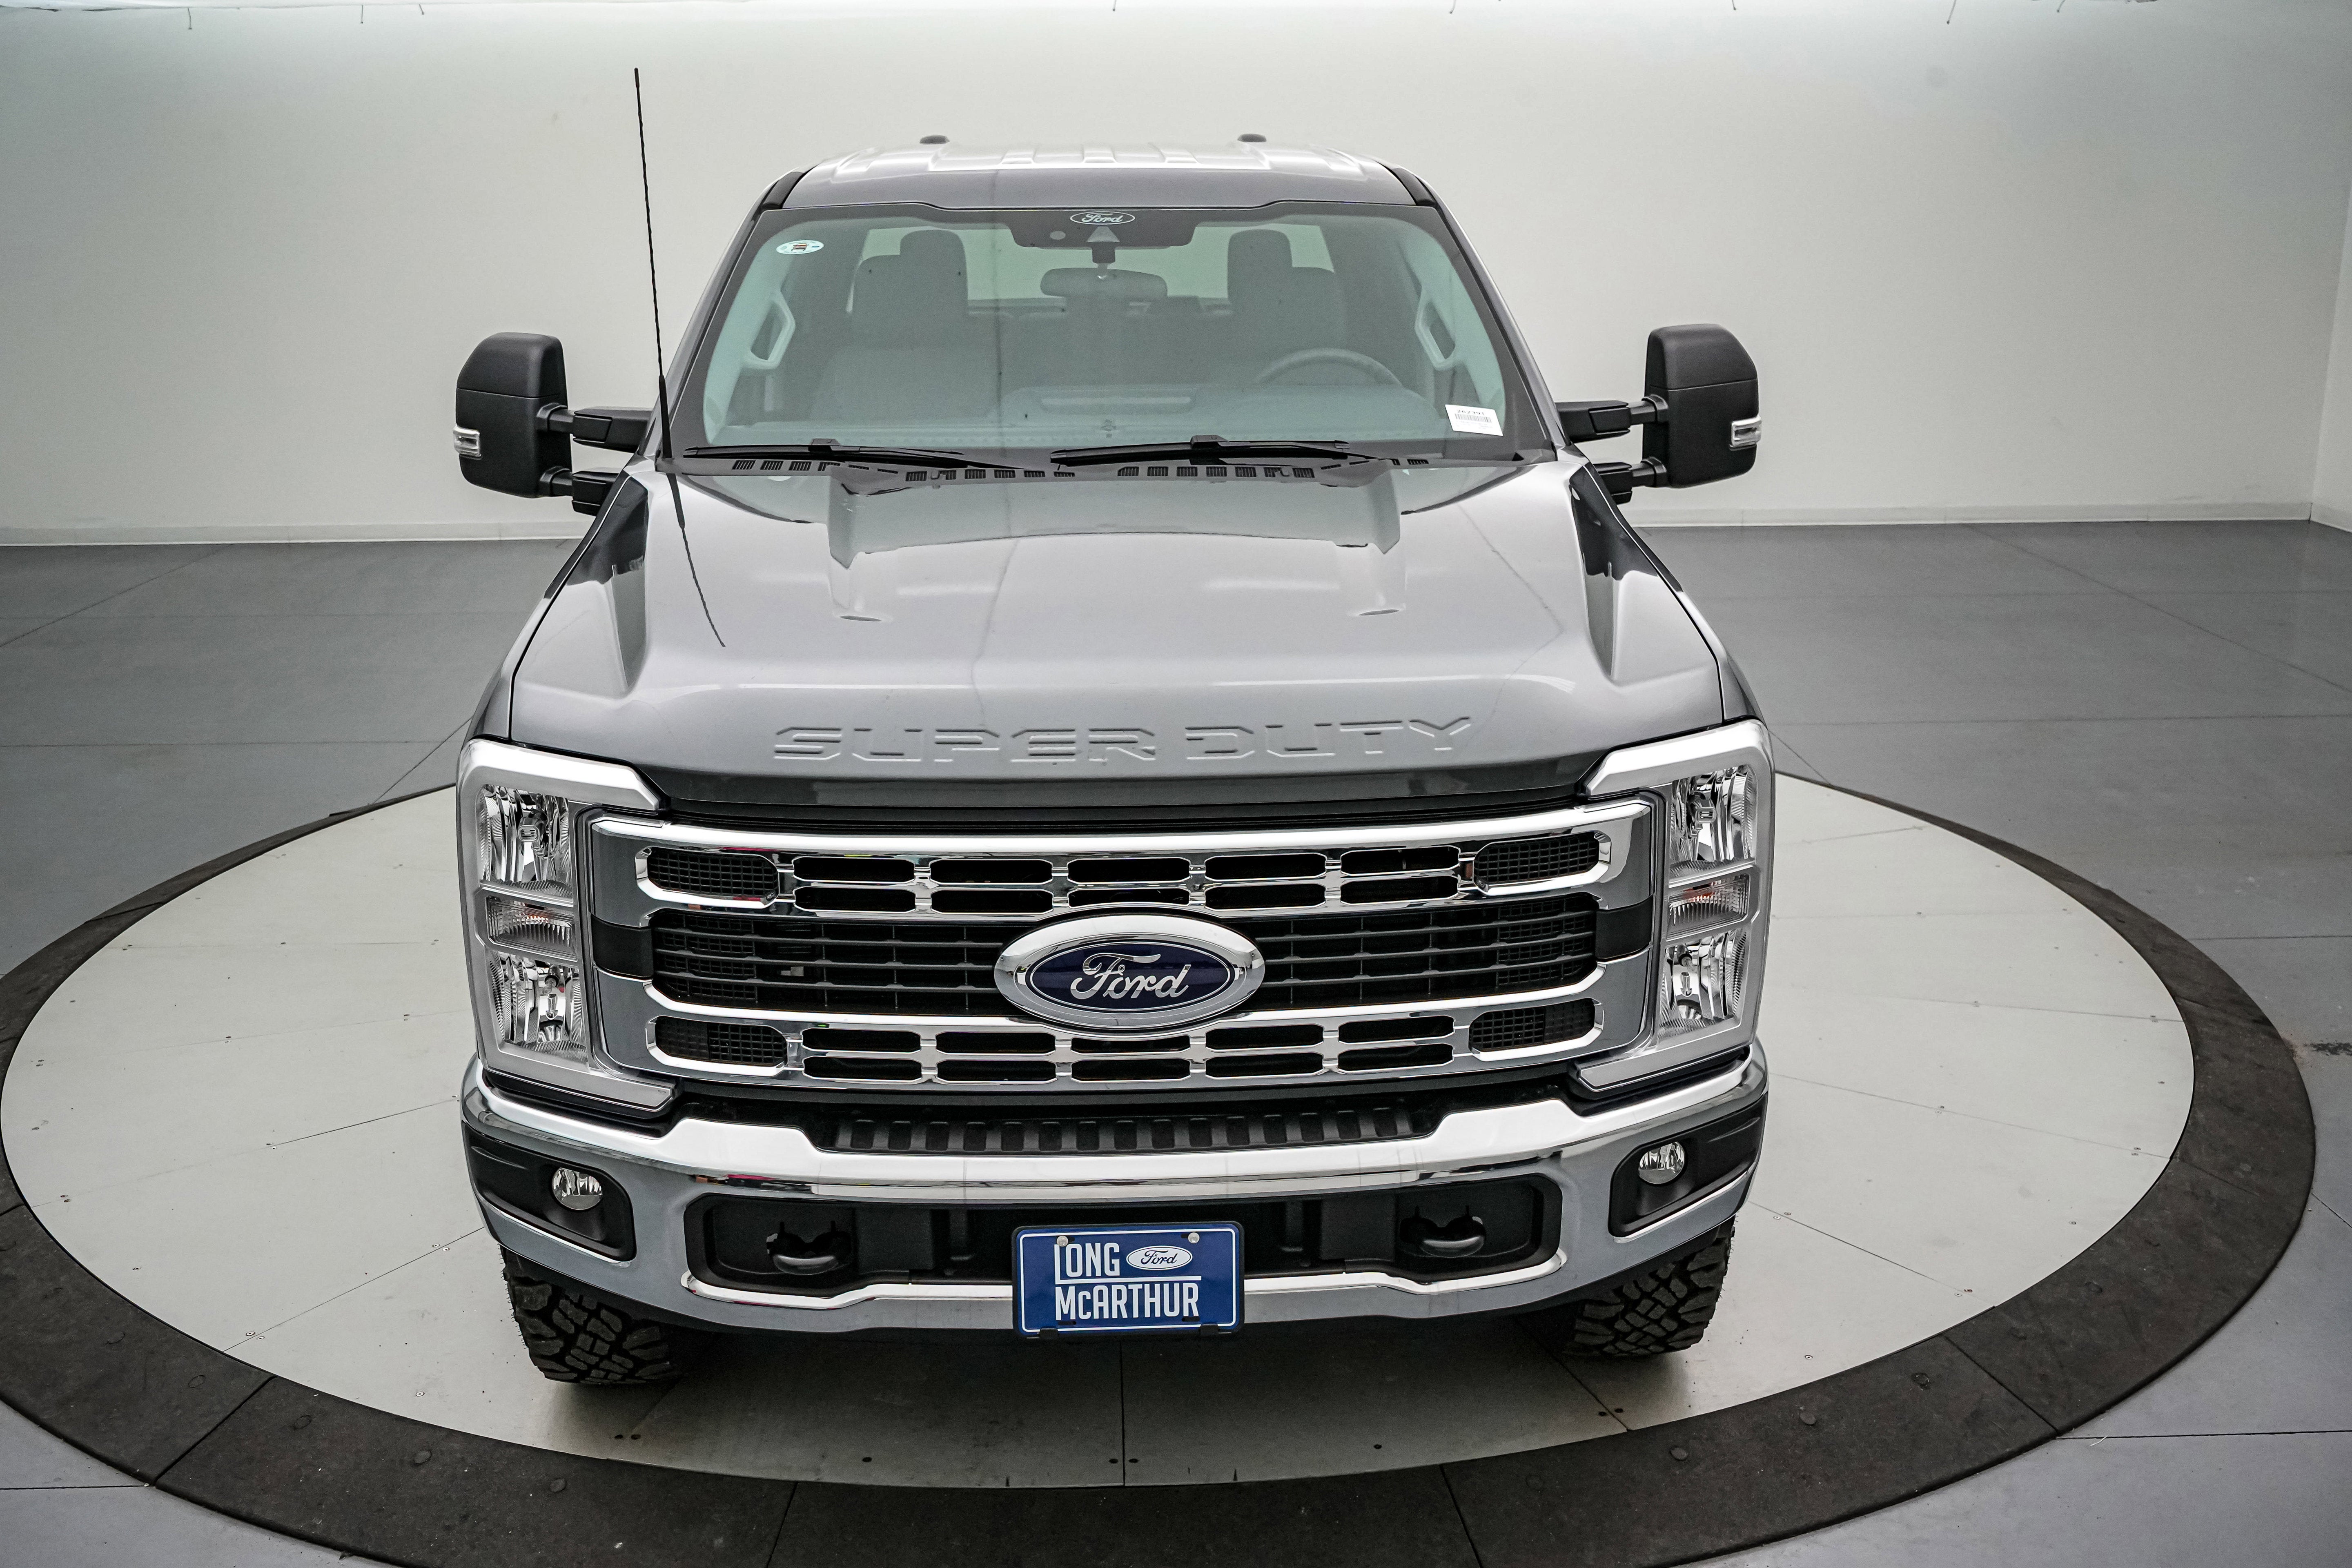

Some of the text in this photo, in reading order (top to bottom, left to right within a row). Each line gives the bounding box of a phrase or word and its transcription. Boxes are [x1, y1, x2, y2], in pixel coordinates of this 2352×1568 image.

[1082, 213, 1123, 223] Ford
[774, 717, 1471, 762] SUPER DUTY
[1070, 952, 1189, 1000] Ford
[1054, 1242, 1178, 1285] LONG Ford
[1055, 1283, 1199, 1321] McARTHUR
